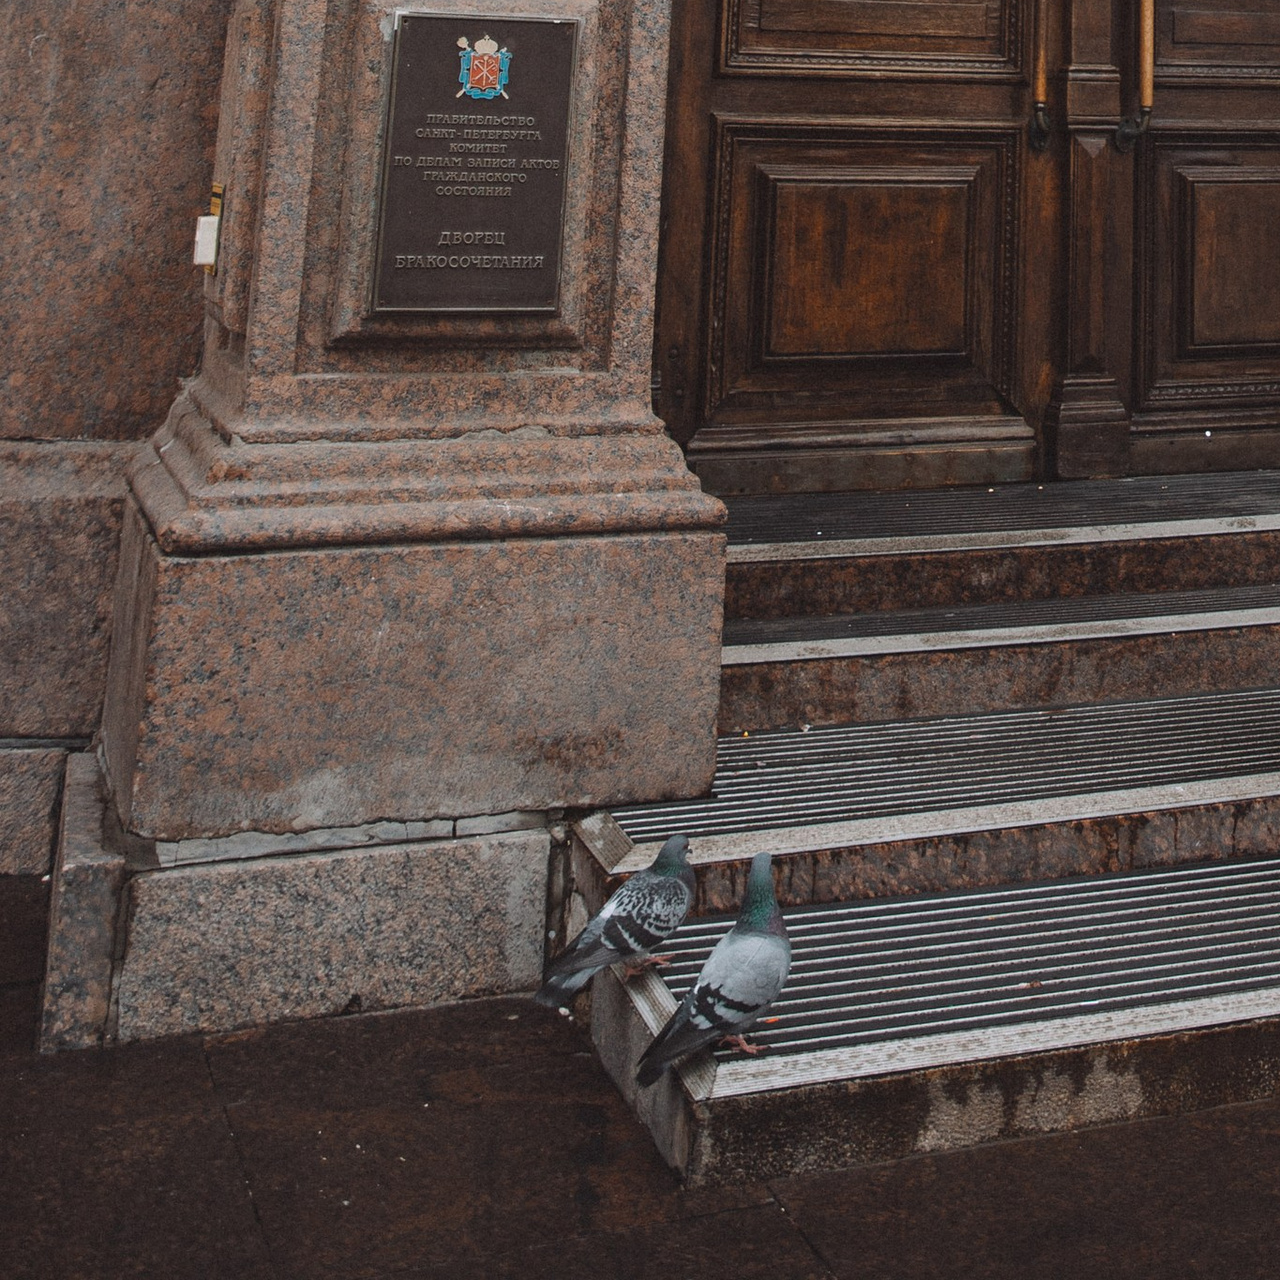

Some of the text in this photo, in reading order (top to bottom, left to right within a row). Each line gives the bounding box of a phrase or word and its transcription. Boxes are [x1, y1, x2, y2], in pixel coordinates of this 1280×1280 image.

[426, 113, 536, 127] ПРАВИТЕЛЬСТВО
[415, 128, 542, 141] САНКТ-ПЕТЕРБУРГА
[448, 142, 509, 154] КОМИТЕТ
[394, 155, 561, 170] ПО ДЕЛАМ ЗАПИСИ АКТОВ
[422, 171, 527, 184] ГРАЖДАНСКОГО
[435, 185, 512, 197] СОСТОЯНИЯ
[438, 231, 506, 246] ДВОРЕЦ
[395, 255, 545, 269] БРАКОСОЧЕТАНИЯ
